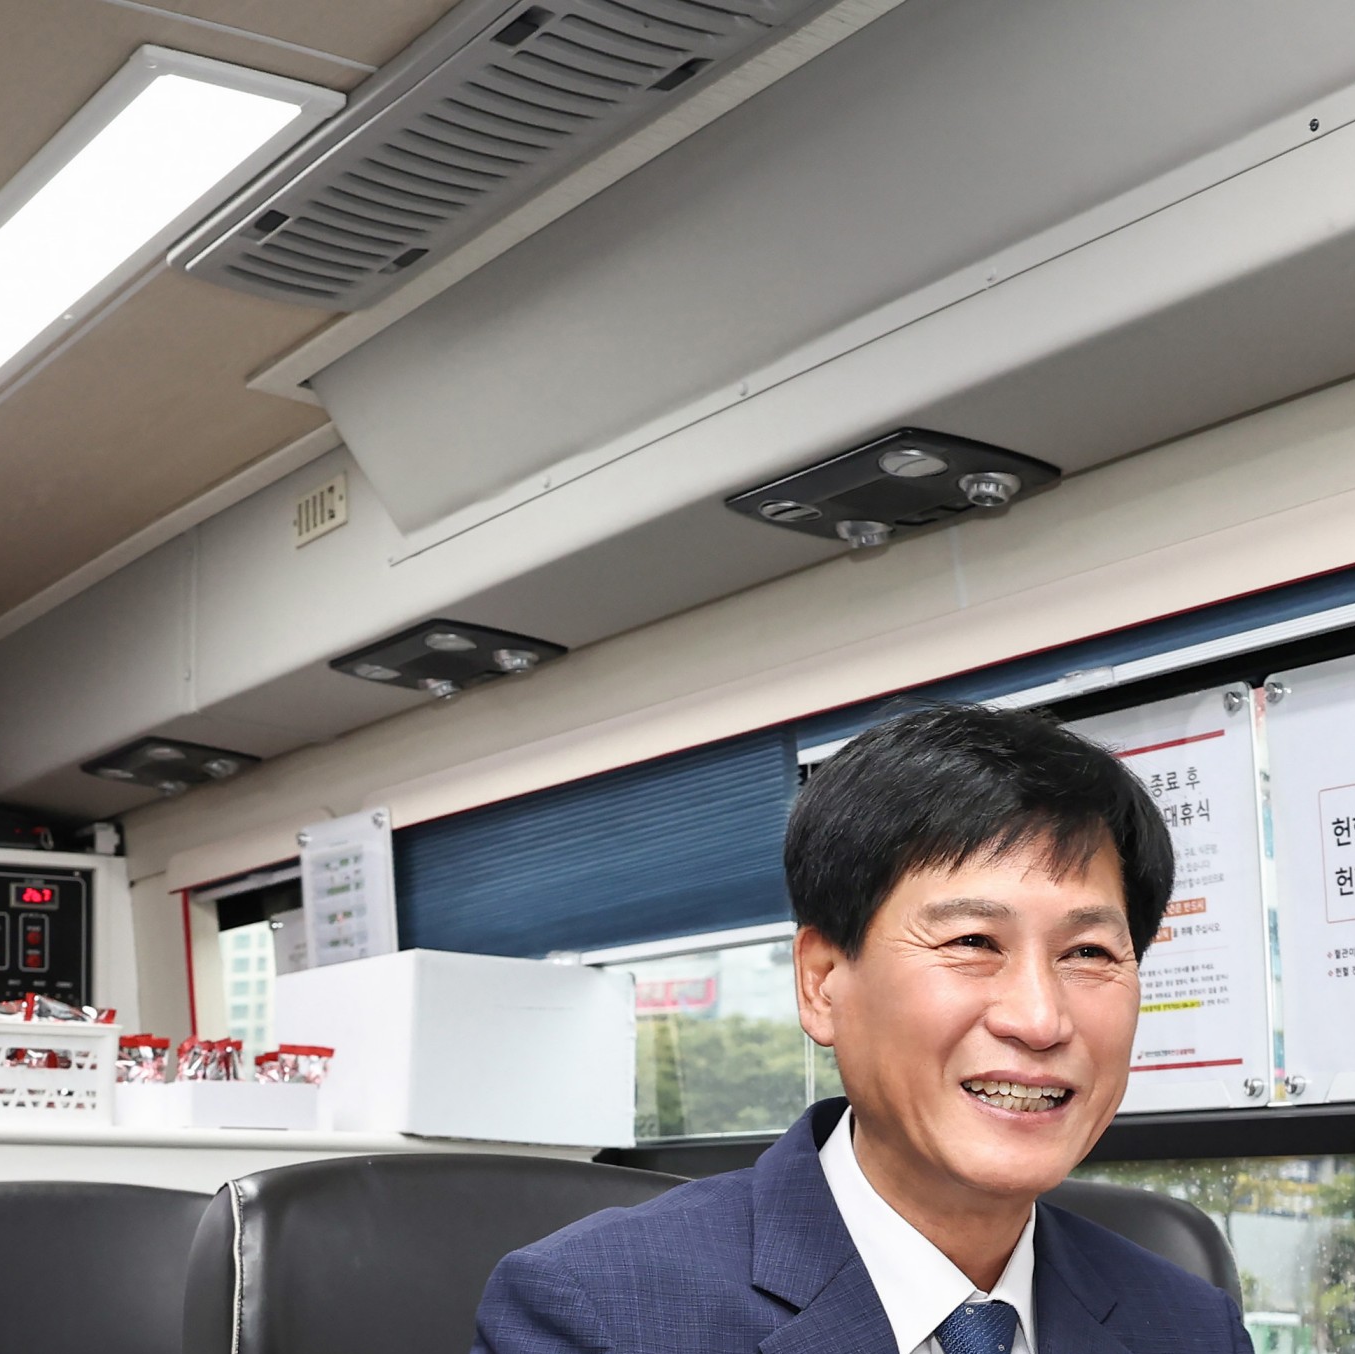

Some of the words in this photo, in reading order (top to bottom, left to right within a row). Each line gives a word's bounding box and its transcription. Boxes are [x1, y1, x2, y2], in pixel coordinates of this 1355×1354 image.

[1149, 771, 1180, 798] 종료
[1185, 766, 1201, 790] 후
[1335, 965, 1350, 978] 헌혈
